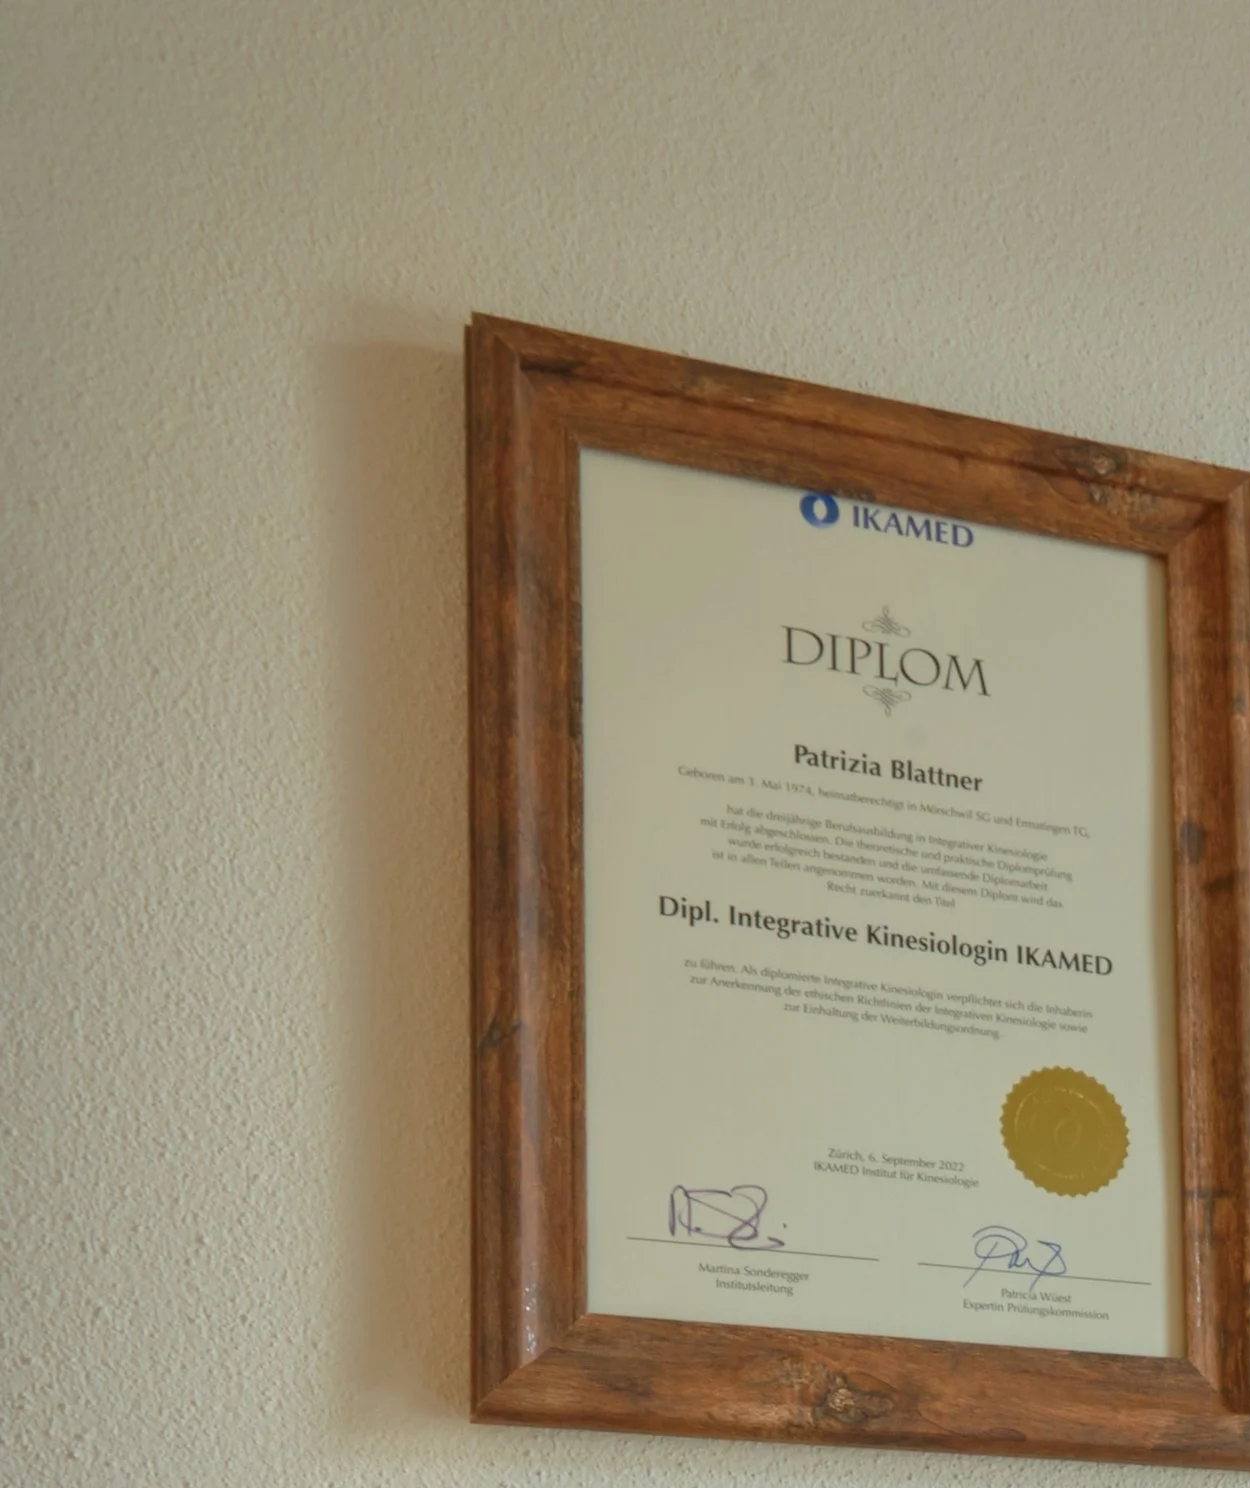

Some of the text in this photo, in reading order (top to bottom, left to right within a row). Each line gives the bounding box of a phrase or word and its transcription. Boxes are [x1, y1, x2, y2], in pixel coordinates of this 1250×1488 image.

[853, 506, 974, 548] IKAMED
[782, 625, 990, 697] DIPLOM
[677, 765, 725, 782] Geboren
[727, 776, 745, 785] am
[794, 744, 983, 792] Patrizia Blattner
[659, 895, 1113, 976] Dipl. Integrative Kinesiologin IKAMED
[828, 1147, 965, 1172] Zürich, 6. September 2022
[813, 1160, 979, 1189] IKAMED Institut für Kinesiologie
[698, 1262, 810, 1284] Martina Sonderegger
[716, 1278, 794, 1297] Institutsleitung
[1001, 1288, 1072, 1304] Patricia Wüest
[963, 1298, 1109, 1320] Expertin Prüfungskommission
